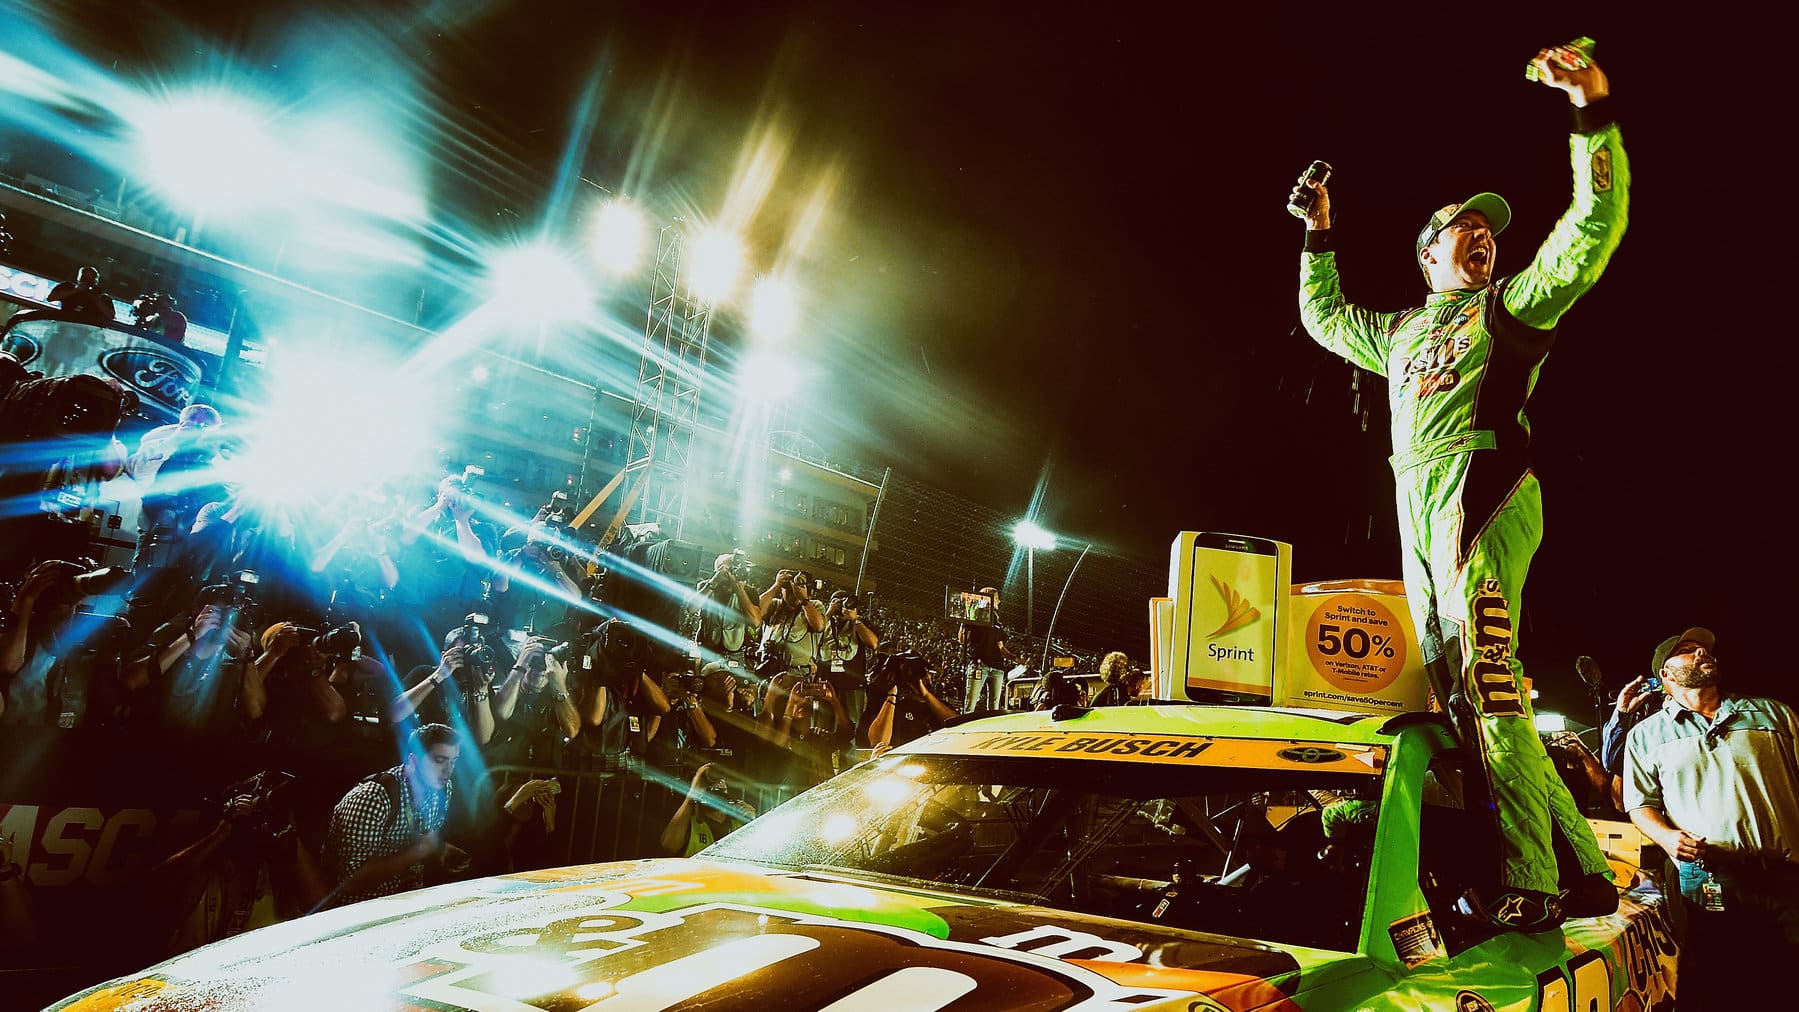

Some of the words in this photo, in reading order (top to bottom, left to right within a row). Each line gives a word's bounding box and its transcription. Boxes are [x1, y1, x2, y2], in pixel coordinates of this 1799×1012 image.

[1325, 612, 1350, 622] Sprint
[1352, 616, 1367, 624] and
[1369, 619, 1388, 627] save
[1337, 605, 1366, 616] Switch
[1367, 609, 1376, 617] to
[1317, 624, 1395, 659] 50%
[1208, 643, 1254, 662] Sprint
[1332, 667, 1360, 676] T-Mobile
[1303, 690, 1404, 708] sprint.com/save50percent
[969, 736, 1067, 751] KYLE
[1054, 737, 1214, 758] BUSCH
